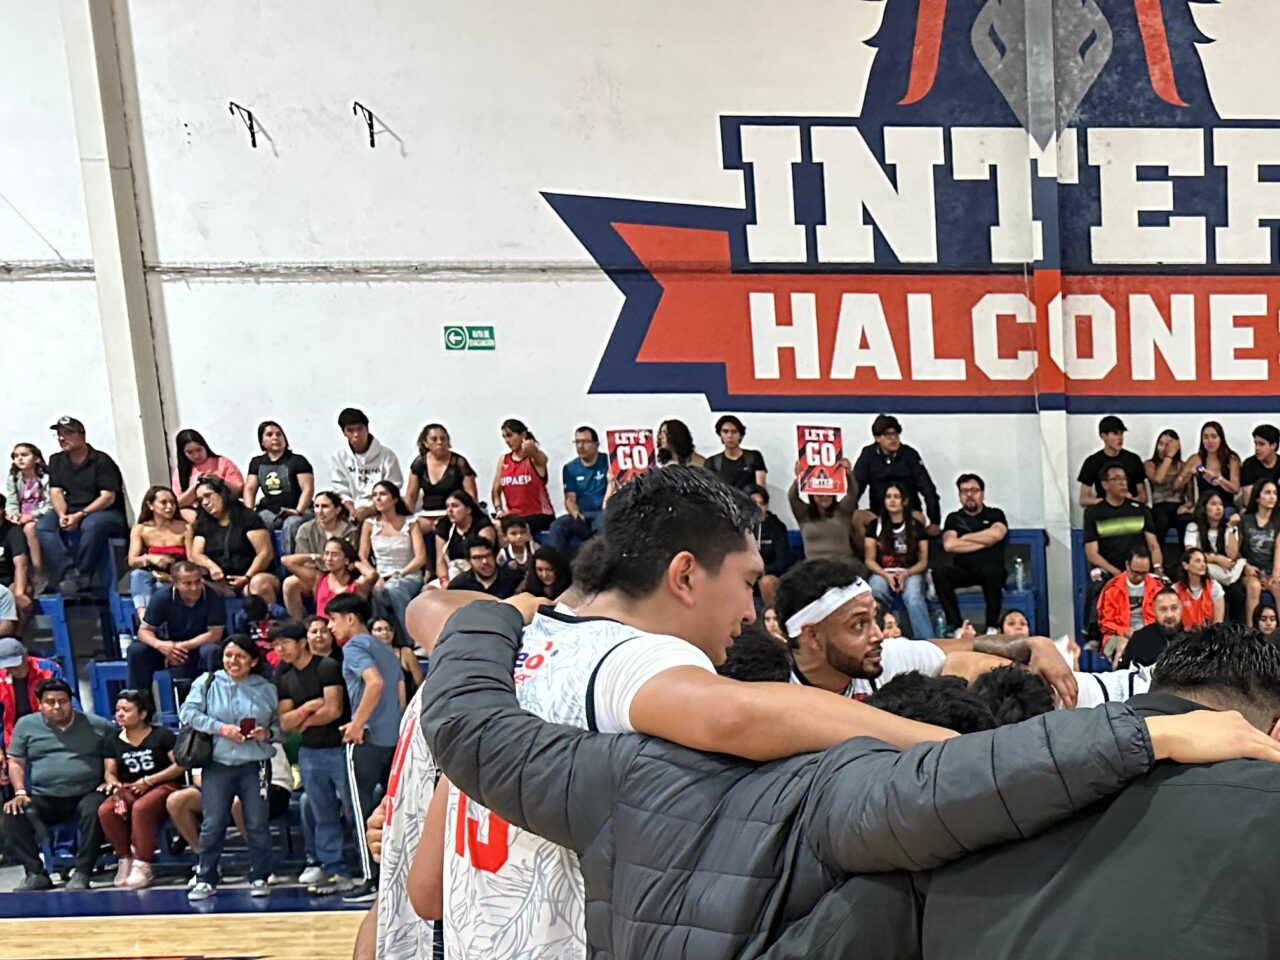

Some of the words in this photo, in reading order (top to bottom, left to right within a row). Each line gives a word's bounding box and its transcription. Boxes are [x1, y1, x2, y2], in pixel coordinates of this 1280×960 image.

[614, 432, 646, 444] LET'S
[804, 429, 834, 441] LET'S
[616, 446, 649, 470] GO
[805, 442, 836, 467] GO
